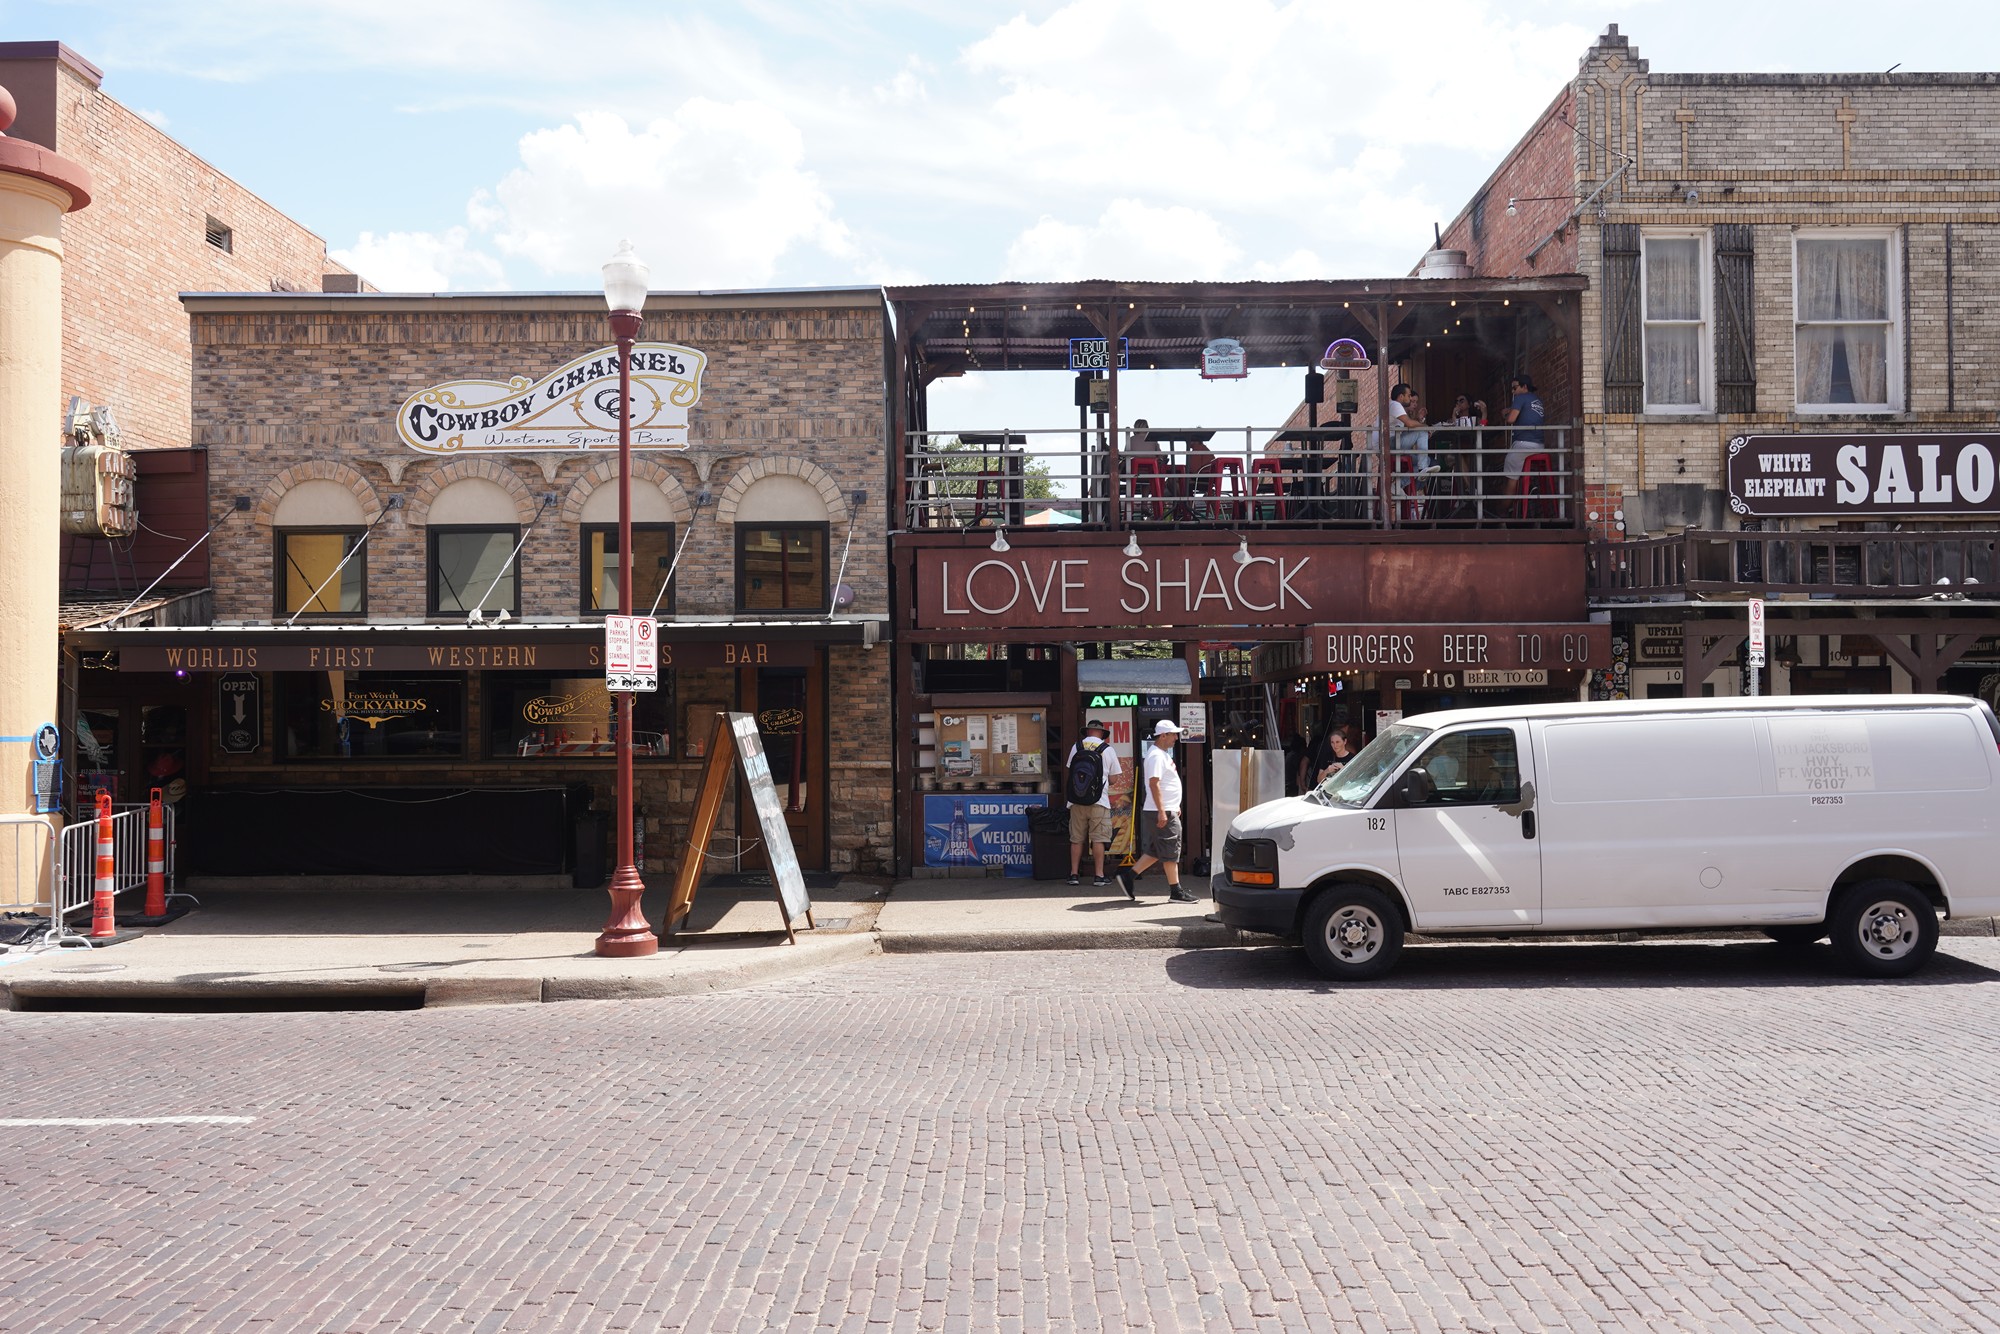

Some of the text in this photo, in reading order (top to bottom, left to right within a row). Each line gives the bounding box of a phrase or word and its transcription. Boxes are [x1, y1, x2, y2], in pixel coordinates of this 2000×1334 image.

[408, 352, 685, 441] COWBOY CHANNEL
[484, 430, 675, 449] Western Sport Bar
[1758, 453, 1811, 473] WHITE
[1836, 443, 2000, 505] SALO
[1744, 477, 1826, 498] ELEPHANT
[942, 556, 1313, 615] LOVE SHACK
[614, 621, 624, 629] NO
[1648, 626, 1683, 637] UPSTAI
[1327, 634, 1414, 664] BURGERS
[1443, 634, 1489, 664] BEER
[1517, 634, 1541, 662] TO
[1563, 634, 1589, 662] GO
[1645, 646, 1676, 655] WHITE
[166, 644, 769, 667] WORLDS FIRST WESTERN BAR
[1422, 673, 1456, 688] 110
[1468, 672, 1544, 684] BEER TO GO
[222, 681, 256, 691] OPEN
[369, 691, 399, 699] Worth
[1090, 694, 1138, 707] ATM
[320, 699, 427, 711] STOCKYARDS
[527, 701, 576, 720] COWBOY
[1102, 721, 1130, 744] TM
[1777, 743, 1868, 754] 1111 JACKSBORO
[1806, 756, 1842, 767] HWY.
[1779, 766, 1871, 779] FT. WORTH, TX
[1806, 778, 1845, 790] 76107
[1812, 796, 1844, 805] P827353
[970, 804, 1000, 815] BUD
[1367, 817, 1386, 831] 182
[981, 831, 1032, 844] WELCOM
[951, 841, 968, 849] BUD
[1001, 844, 1027, 853] TO THE
[949, 848, 969, 856] LIGHT
[981, 853, 1033, 865] STOCKYAR
[1443, 887, 1511, 896] TABC E827353
